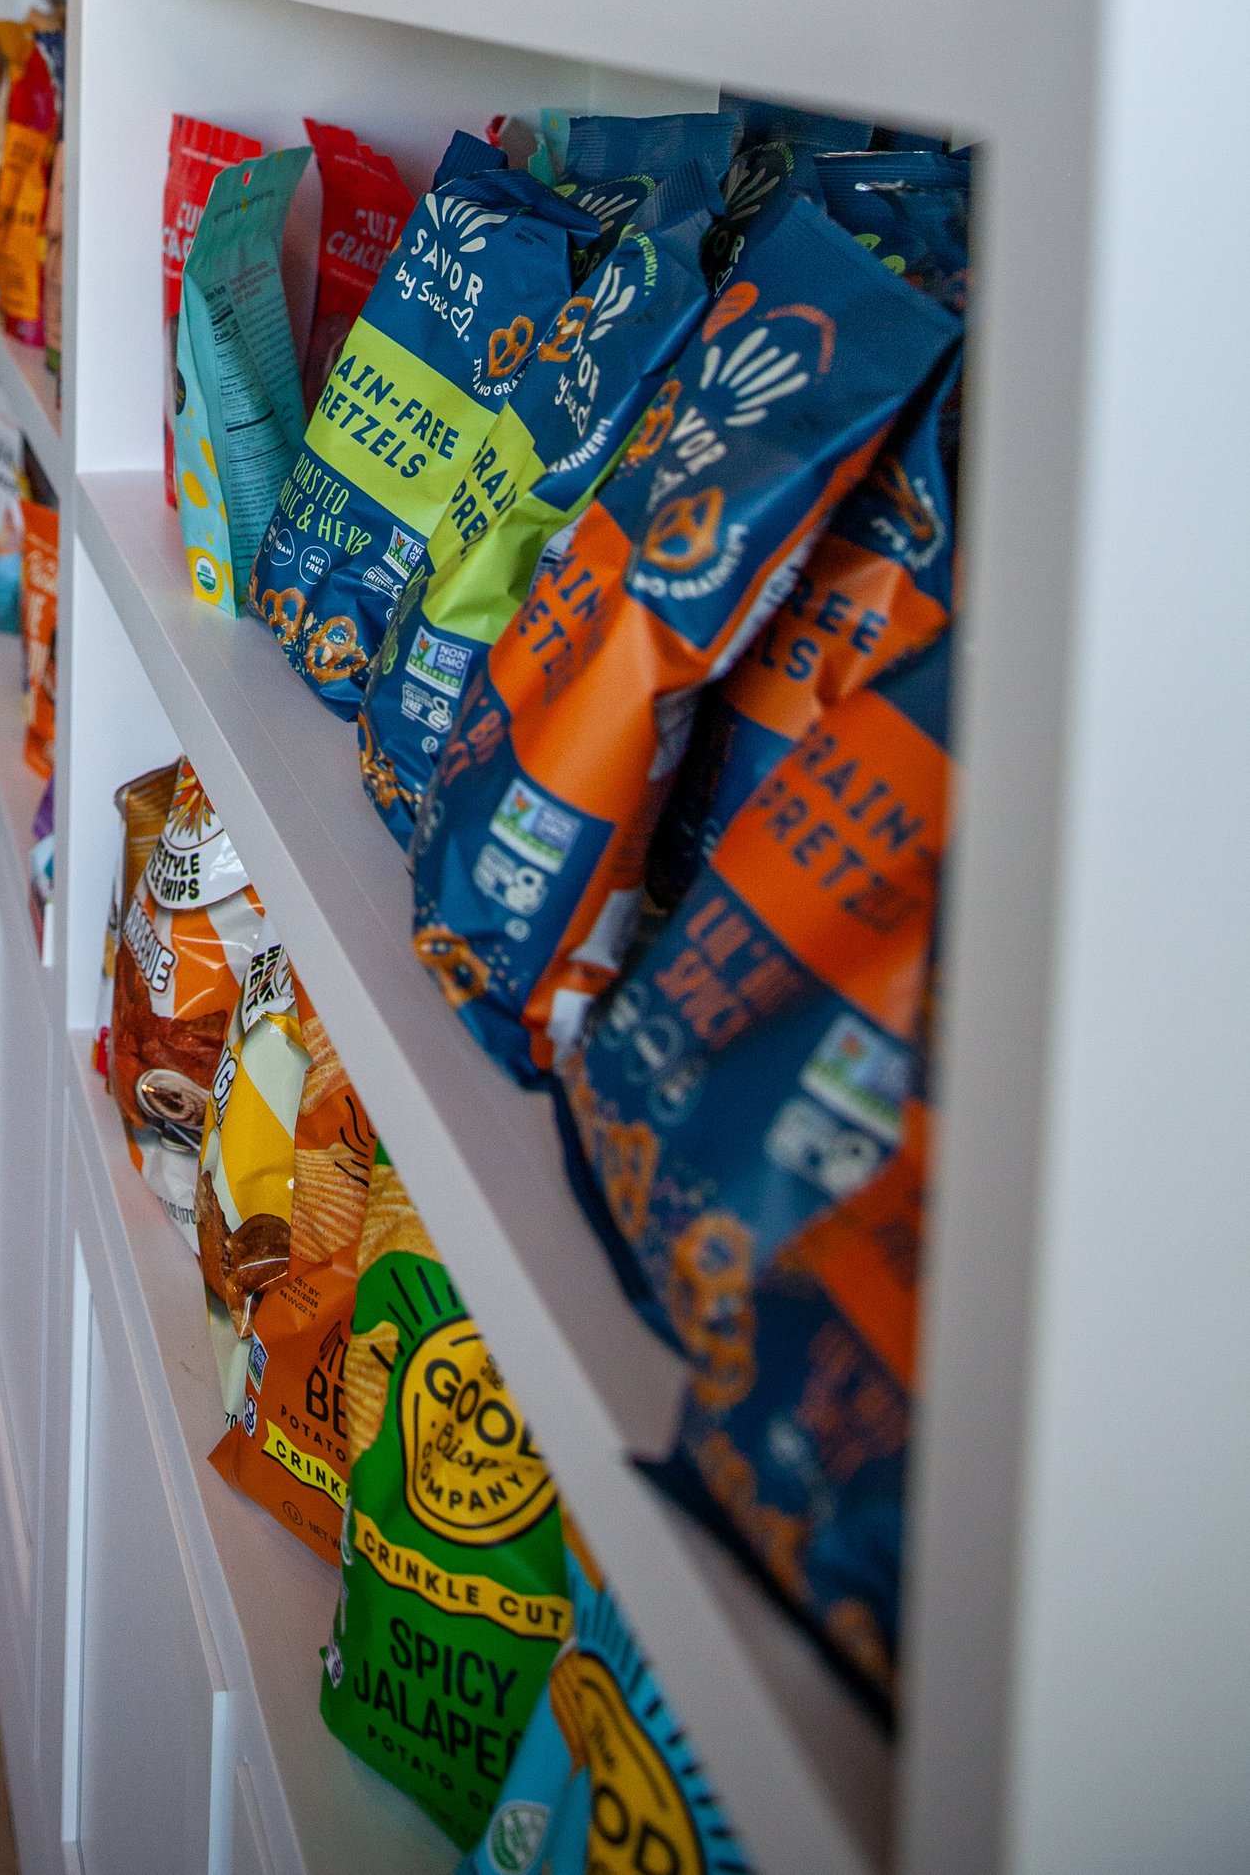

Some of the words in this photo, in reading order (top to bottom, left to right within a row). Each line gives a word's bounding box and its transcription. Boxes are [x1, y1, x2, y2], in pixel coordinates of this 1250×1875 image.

[410, 228, 484, 307] SAVOR
[394, 261, 417, 300] by
[417, 280, 449, 320] Suzie
[477, 384, 490, 397] NO
[319, 384, 427, 479] RETZELS
[292, 452, 350, 515] ROASTED
[296, 503, 315, 533] &
[317, 513, 372, 556] HERB
[305, 561, 323, 576] FREE
[309, 553, 326, 567] NUT
[408, 657, 459, 689] VERIFIED
[436, 655, 464, 671] GMO
[439, 644, 467, 662] NON
[404, 688, 435, 709] GLUTEN
[404, 700, 423, 714] FREE
[160, 877, 200, 902] CHIPS
[293, 1275, 308, 1290] EST
[308, 1286, 323, 1301] BY:
[280, 1403, 348, 1464] POTATO
[275, 1438, 348, 1500] CRINK
[363, 1529, 480, 1608] CRINKLE
[498, 1593, 565, 1632] CUT
[389, 1616, 517, 1719] SPICY
[366, 1723, 454, 1791] POTATO
